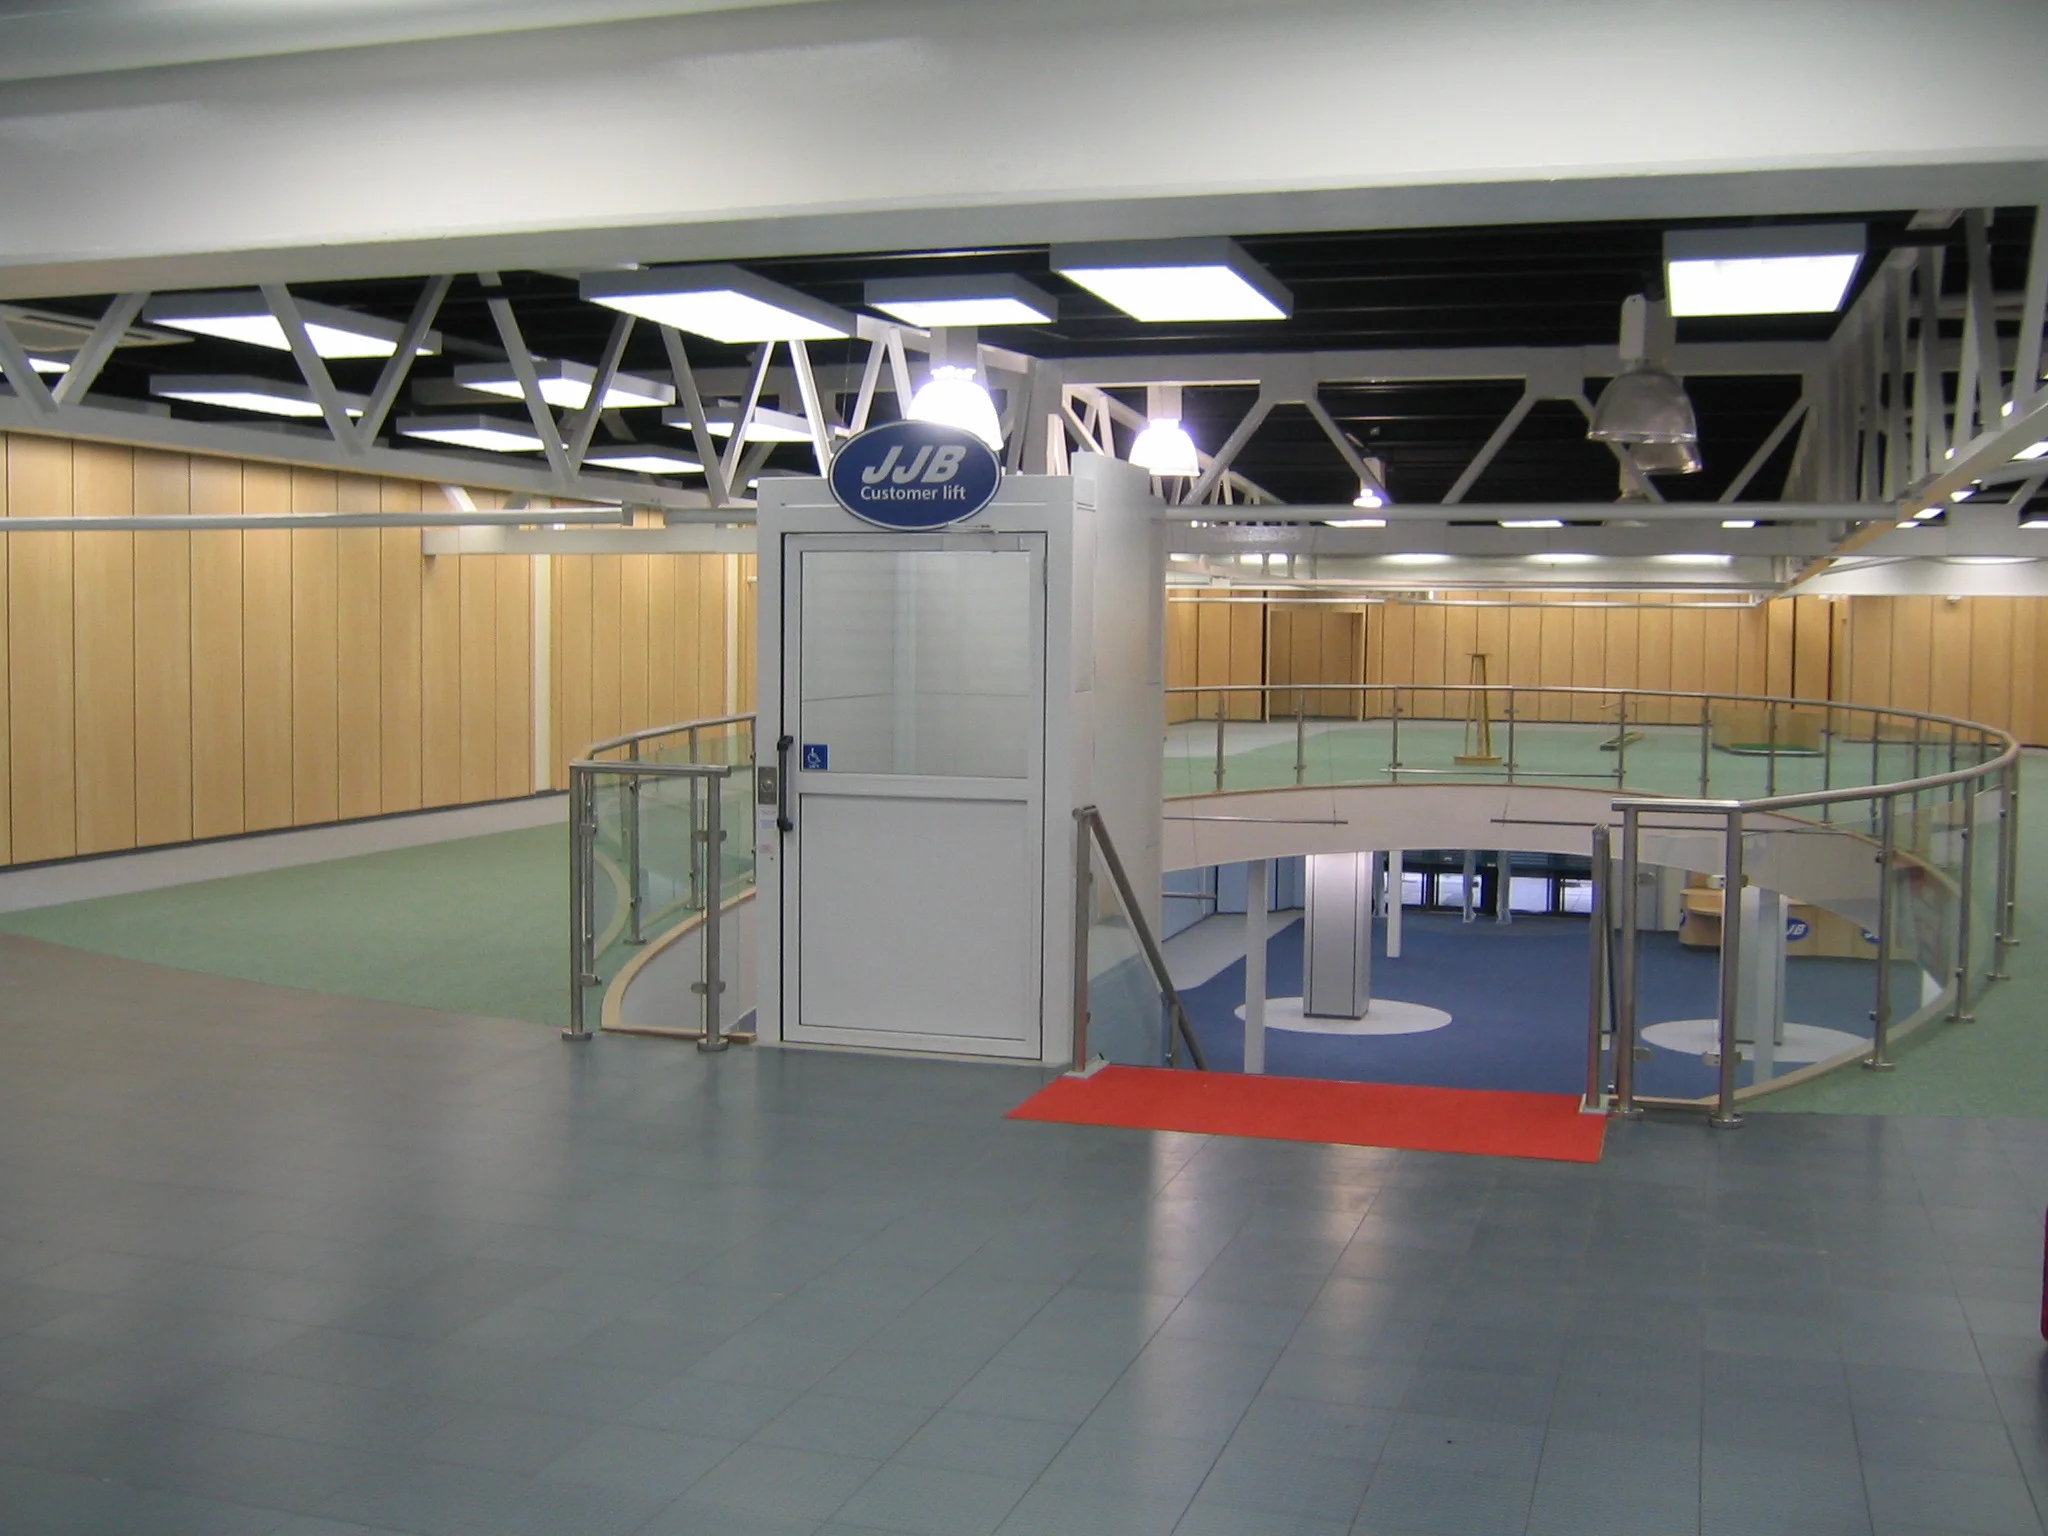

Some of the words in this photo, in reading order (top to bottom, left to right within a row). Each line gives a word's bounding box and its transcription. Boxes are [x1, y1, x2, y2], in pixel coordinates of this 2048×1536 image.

[862, 445, 968, 484] JJB
[860, 486, 938, 500] Customer
[943, 485, 967, 500] lift
[1787, 924, 1806, 935] JB
